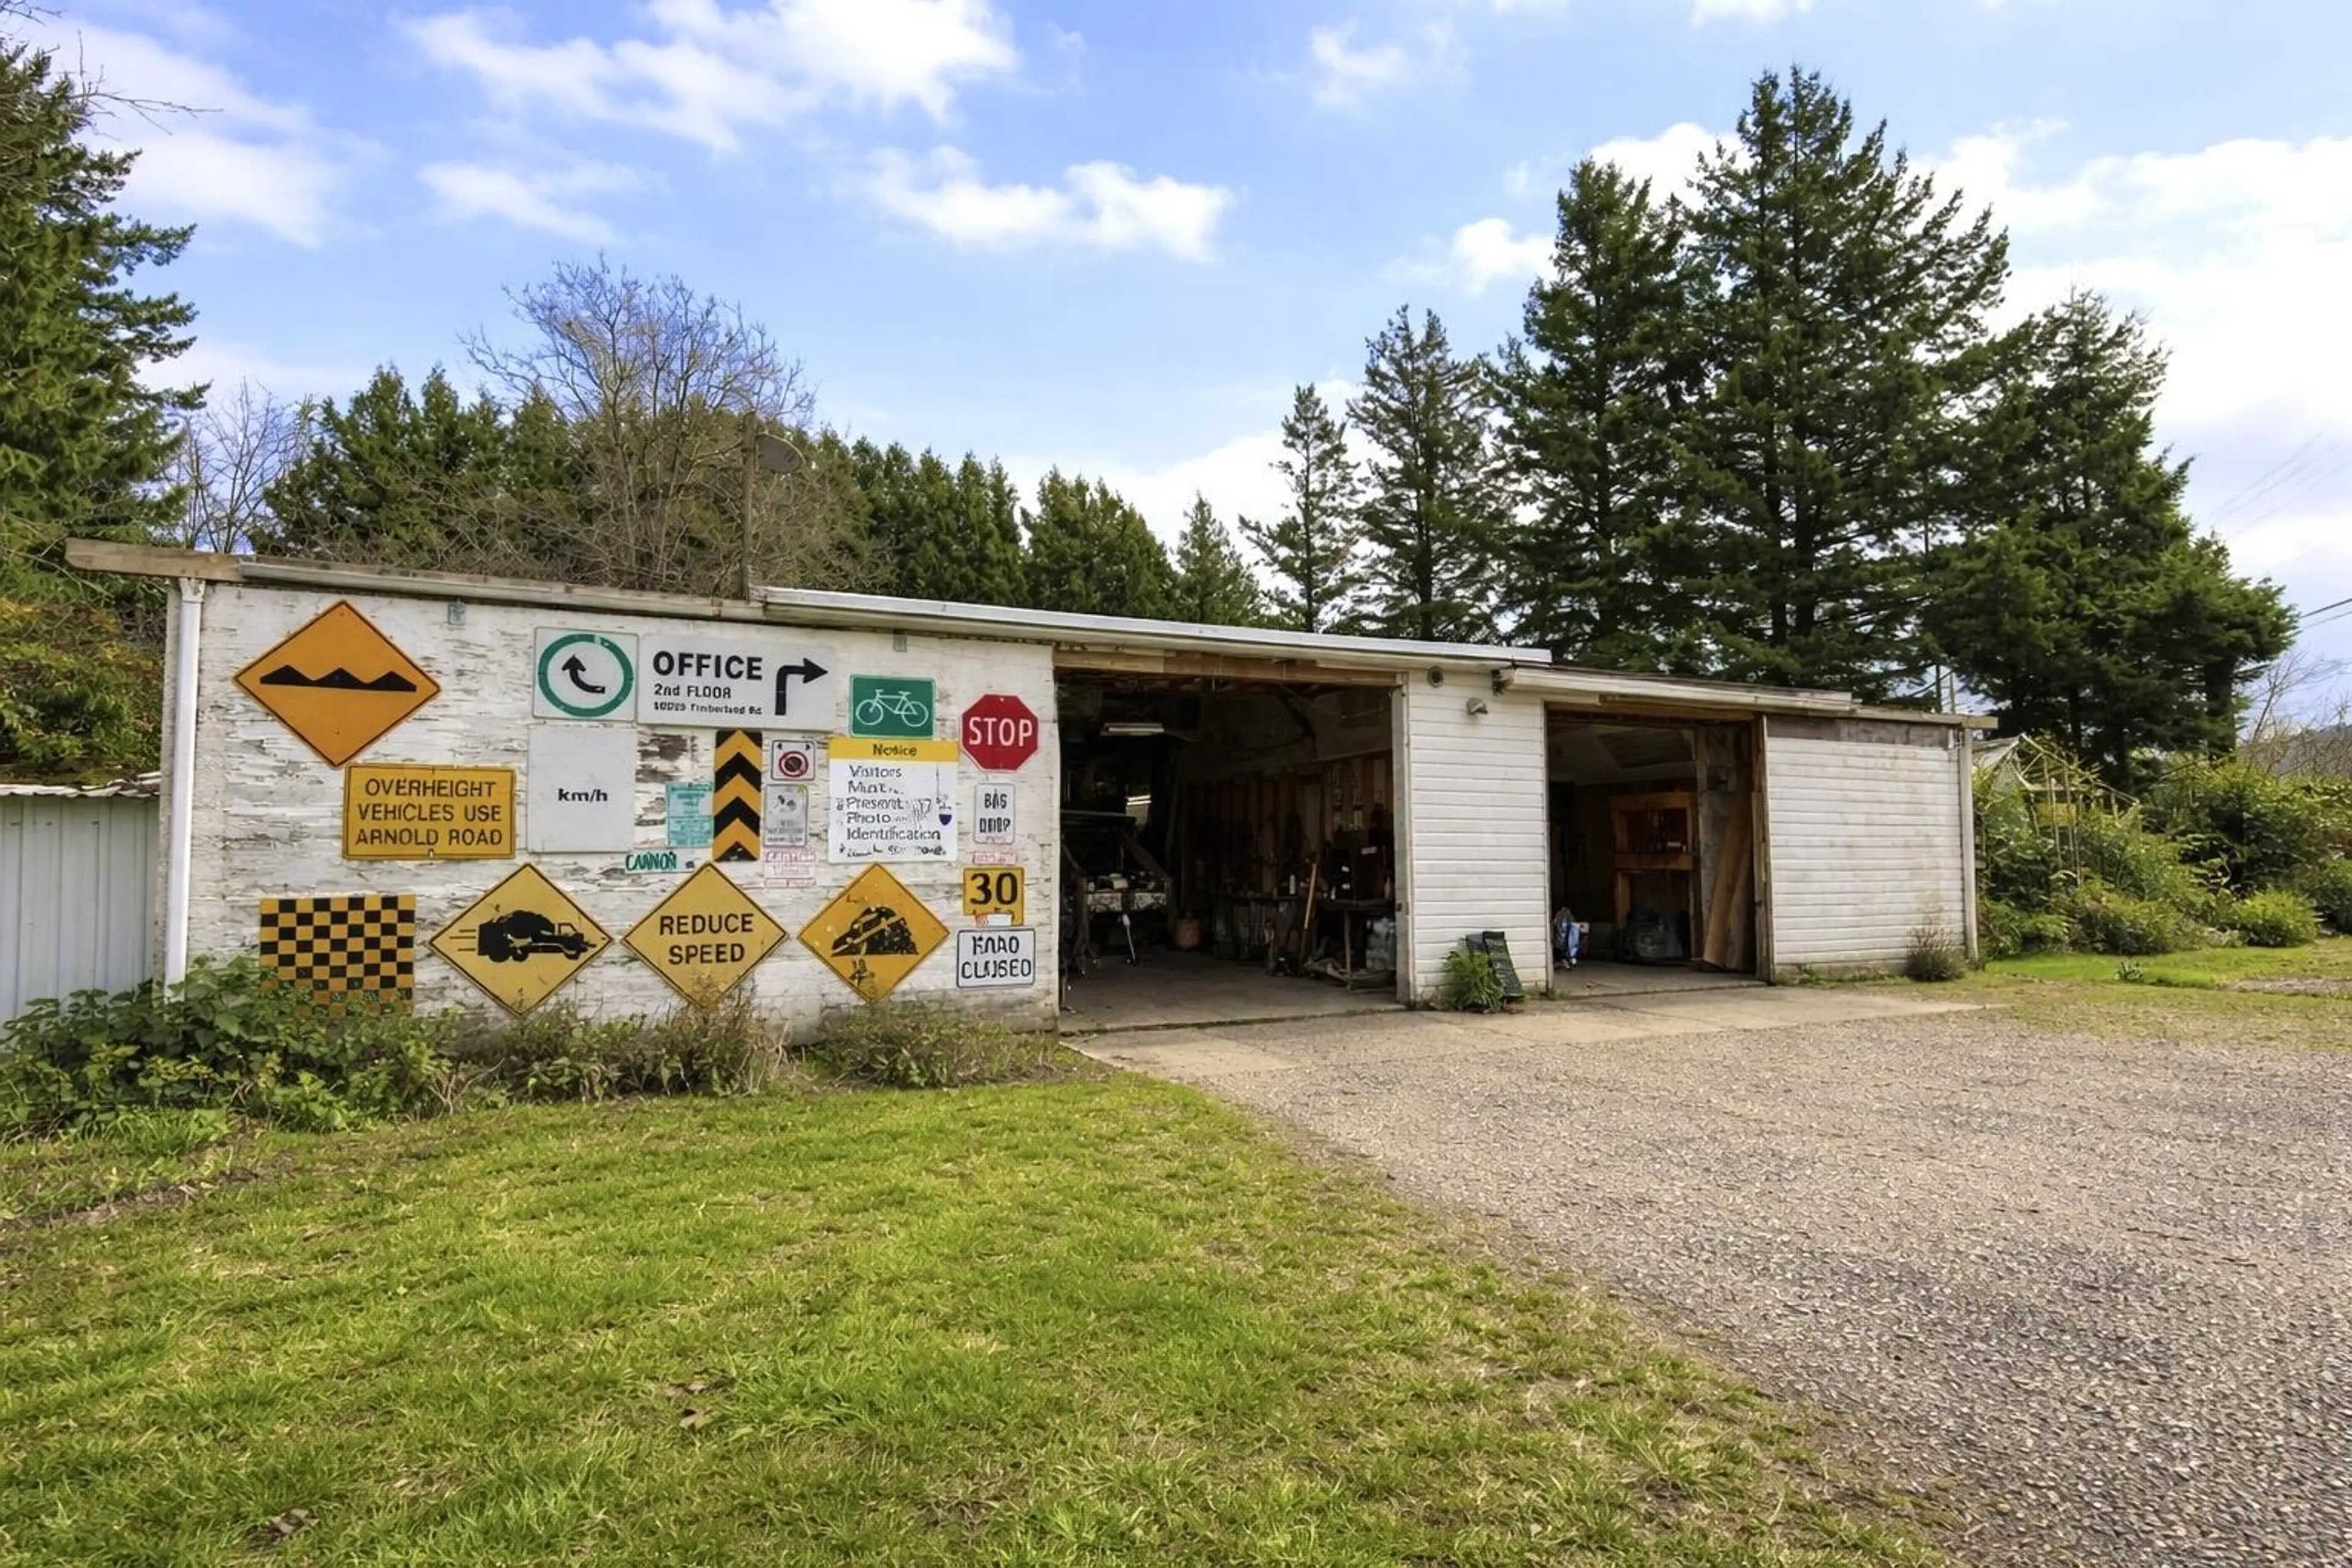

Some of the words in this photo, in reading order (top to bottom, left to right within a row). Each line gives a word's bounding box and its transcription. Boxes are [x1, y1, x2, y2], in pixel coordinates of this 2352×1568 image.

[652, 650, 763, 681] OFFICE
[654, 684, 680, 697] 2nd
[687, 685, 731, 699] FLOOR
[969, 717, 1033, 747] STOP
[873, 744, 918, 756] Notice
[365, 778, 497, 798] OVERHEIGHT
[558, 787, 608, 803] km/h
[358, 803, 454, 822] VEHICLES
[464, 805, 502, 822] USE
[356, 828, 439, 846] ARNOLD
[448, 829, 502, 846] ROAD
[970, 872, 1018, 905] 30
[660, 913, 754, 935] REDUCE
[668, 943, 745, 965] SPEED
